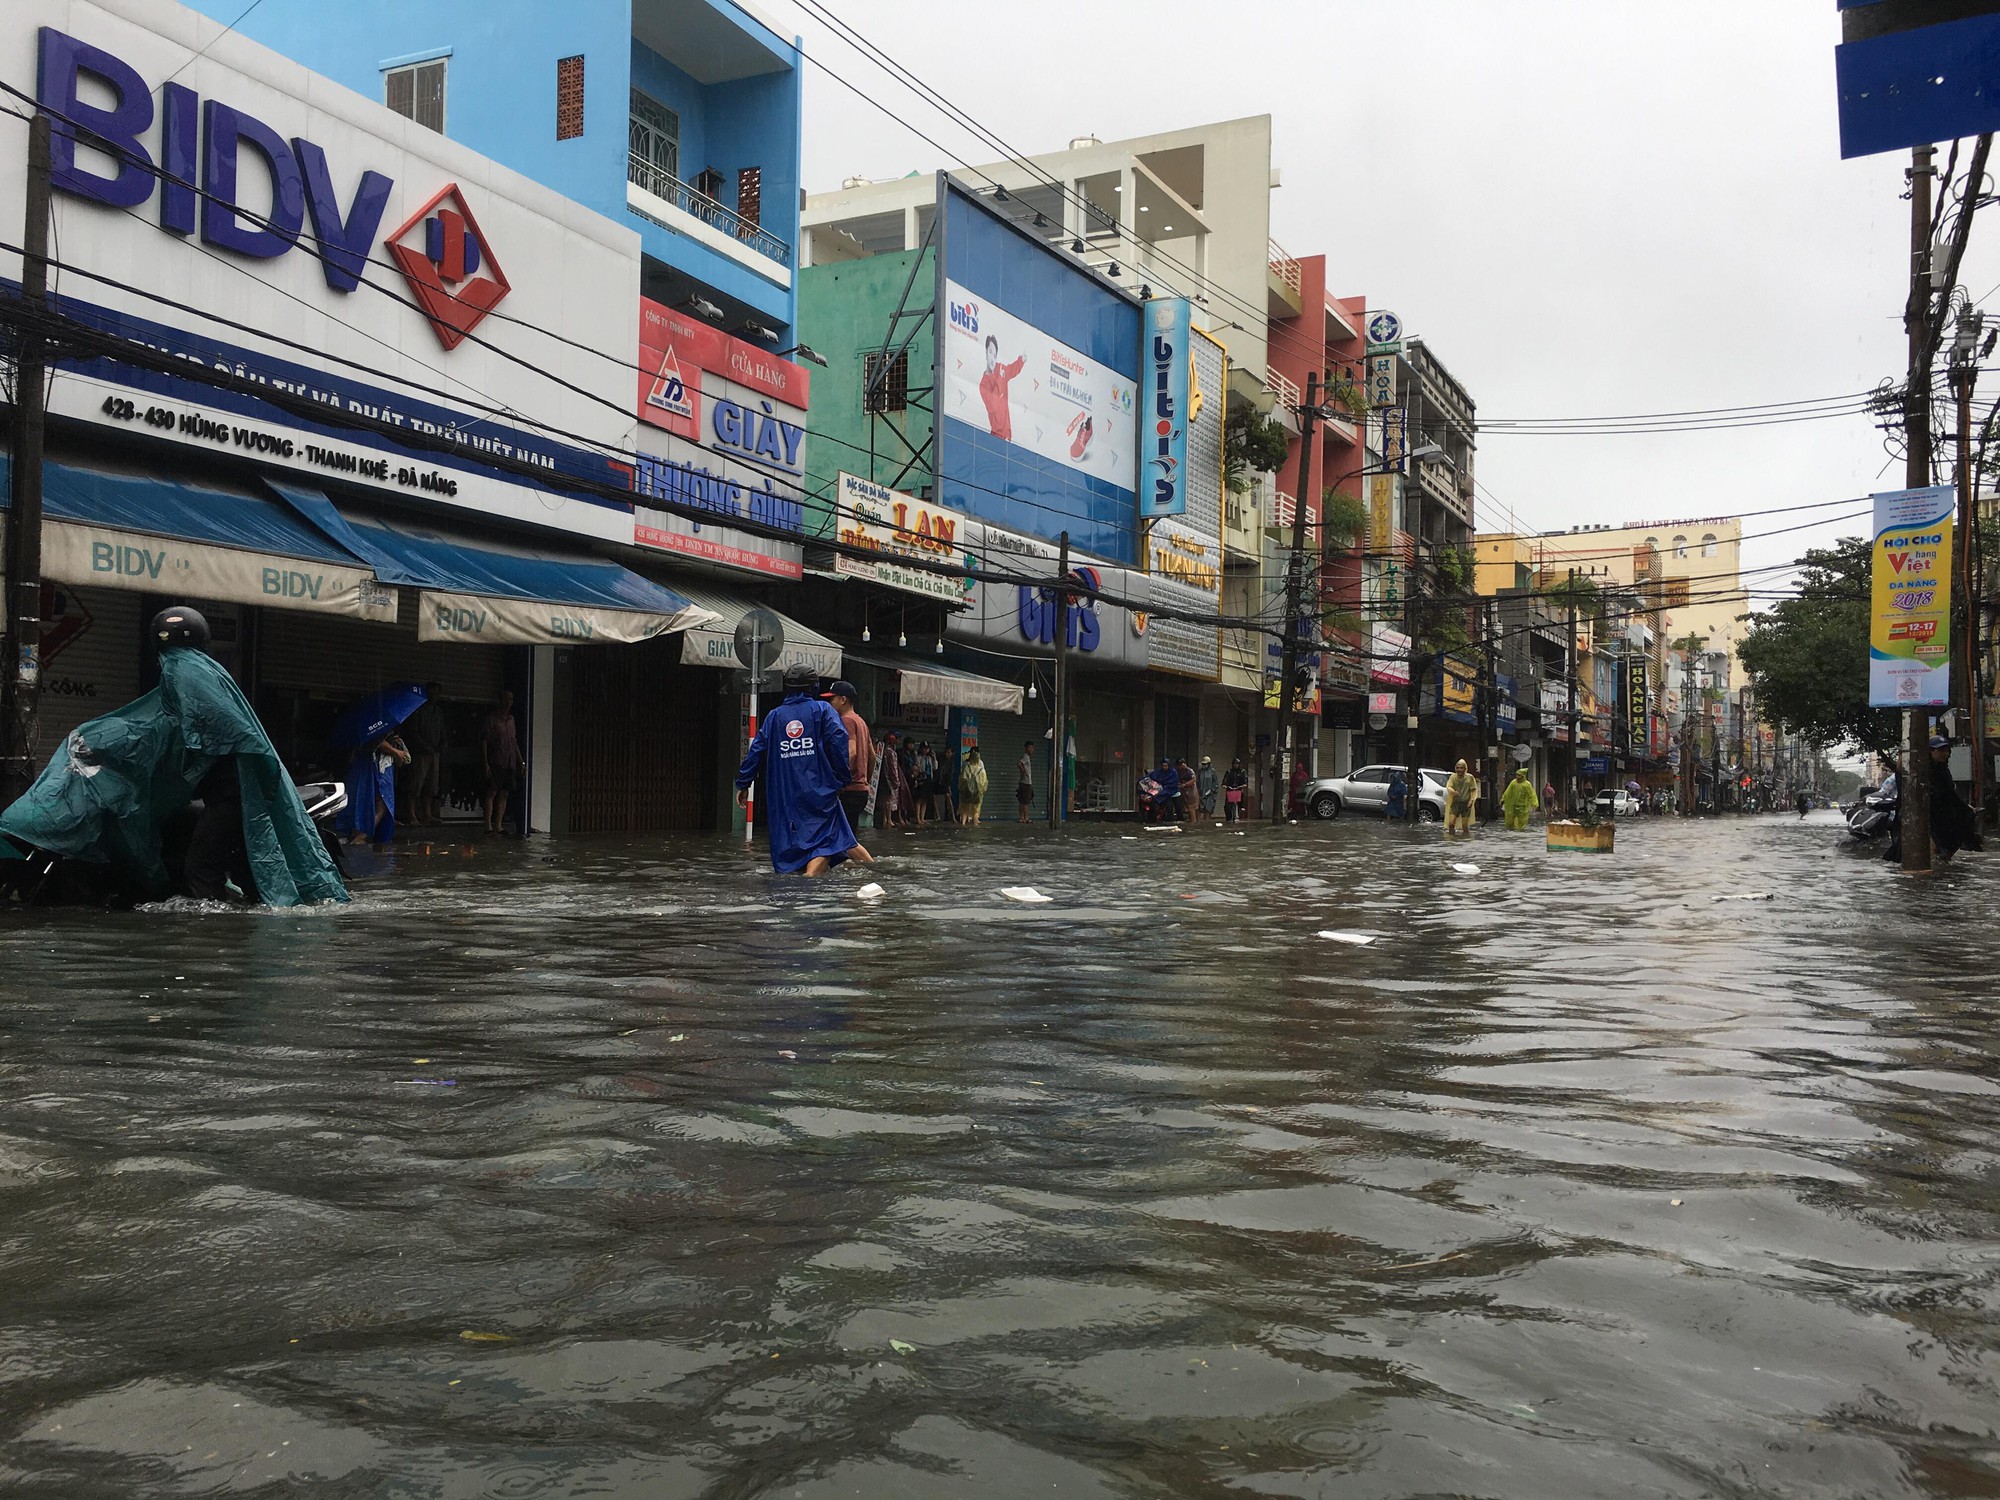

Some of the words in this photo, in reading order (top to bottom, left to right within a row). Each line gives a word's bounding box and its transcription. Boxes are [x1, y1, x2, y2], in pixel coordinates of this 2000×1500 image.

[37, 25, 394, 293] BIDV
[646, 310, 661, 325] CÔNG
[662, 318, 668, 328] TY
[731, 351, 753, 376] CỬA
[755, 362, 786, 389] HÀNG
[713, 397, 805, 465] GIÀY
[180, 413, 229, 443] HÙNG
[232, 427, 293, 458] VƯƠNG
[306, 445, 357, 472] THANH
[360, 459, 388, 482] KHÊ
[516, 450, 555, 471] NAM
[854, 502, 882, 524] Quán
[1653, 519, 1669, 529] ANH
[1672, 518, 1700, 528] PLAZA
[1703, 516, 1731, 526] HOTEL
[892, 502, 956, 555] LAN
[93, 541, 167, 579] BIDV
[1887, 551, 1931, 575] Việt
[262, 566, 324, 600] BIDV
[1889, 590, 1935, 611] 2018
[436, 606, 487, 633] BIDV
[551, 616, 594, 639] BIDV
[1908, 622, 1934, 631] 12-17
[707, 637, 734, 659] GIÀY
[780, 737, 814, 752] SCB
